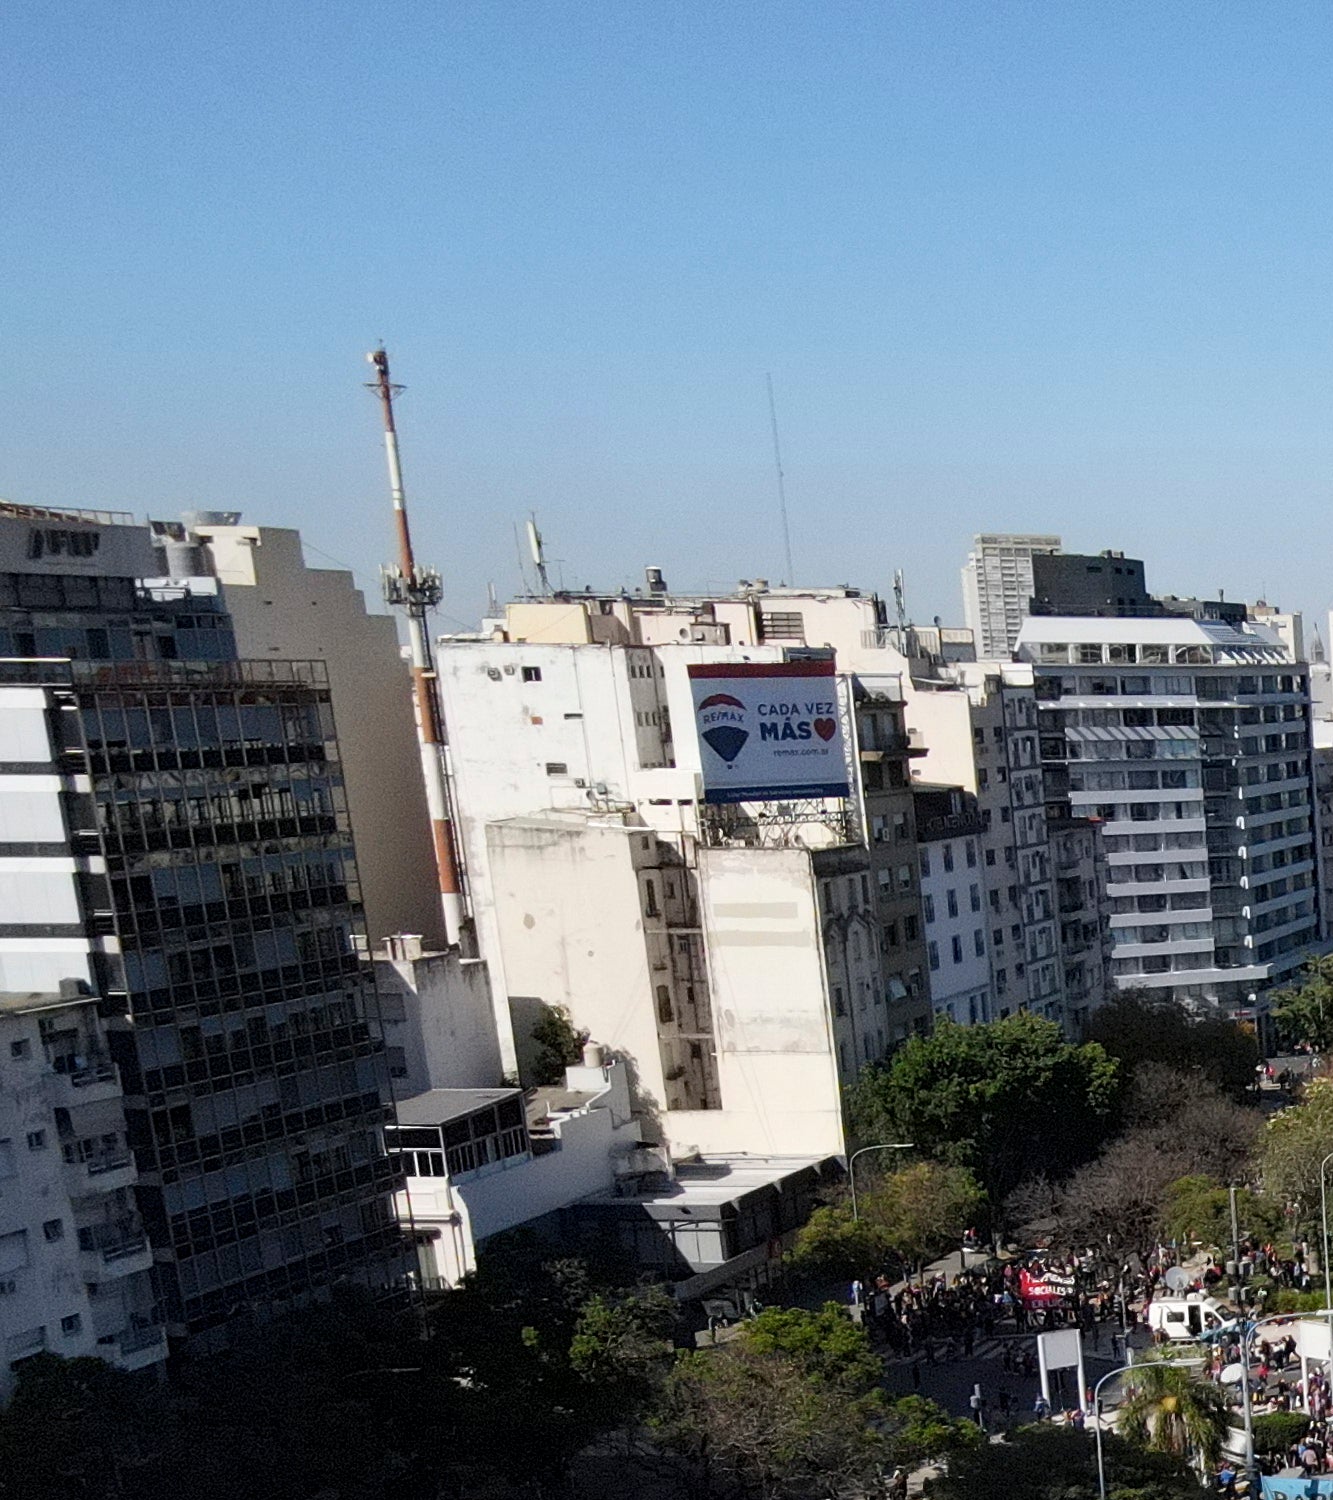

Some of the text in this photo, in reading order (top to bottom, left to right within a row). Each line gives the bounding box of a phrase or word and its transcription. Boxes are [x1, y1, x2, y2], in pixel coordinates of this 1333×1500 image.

[757, 701, 834, 717] CADA VEZ
[759, 717, 812, 742] MÁS
